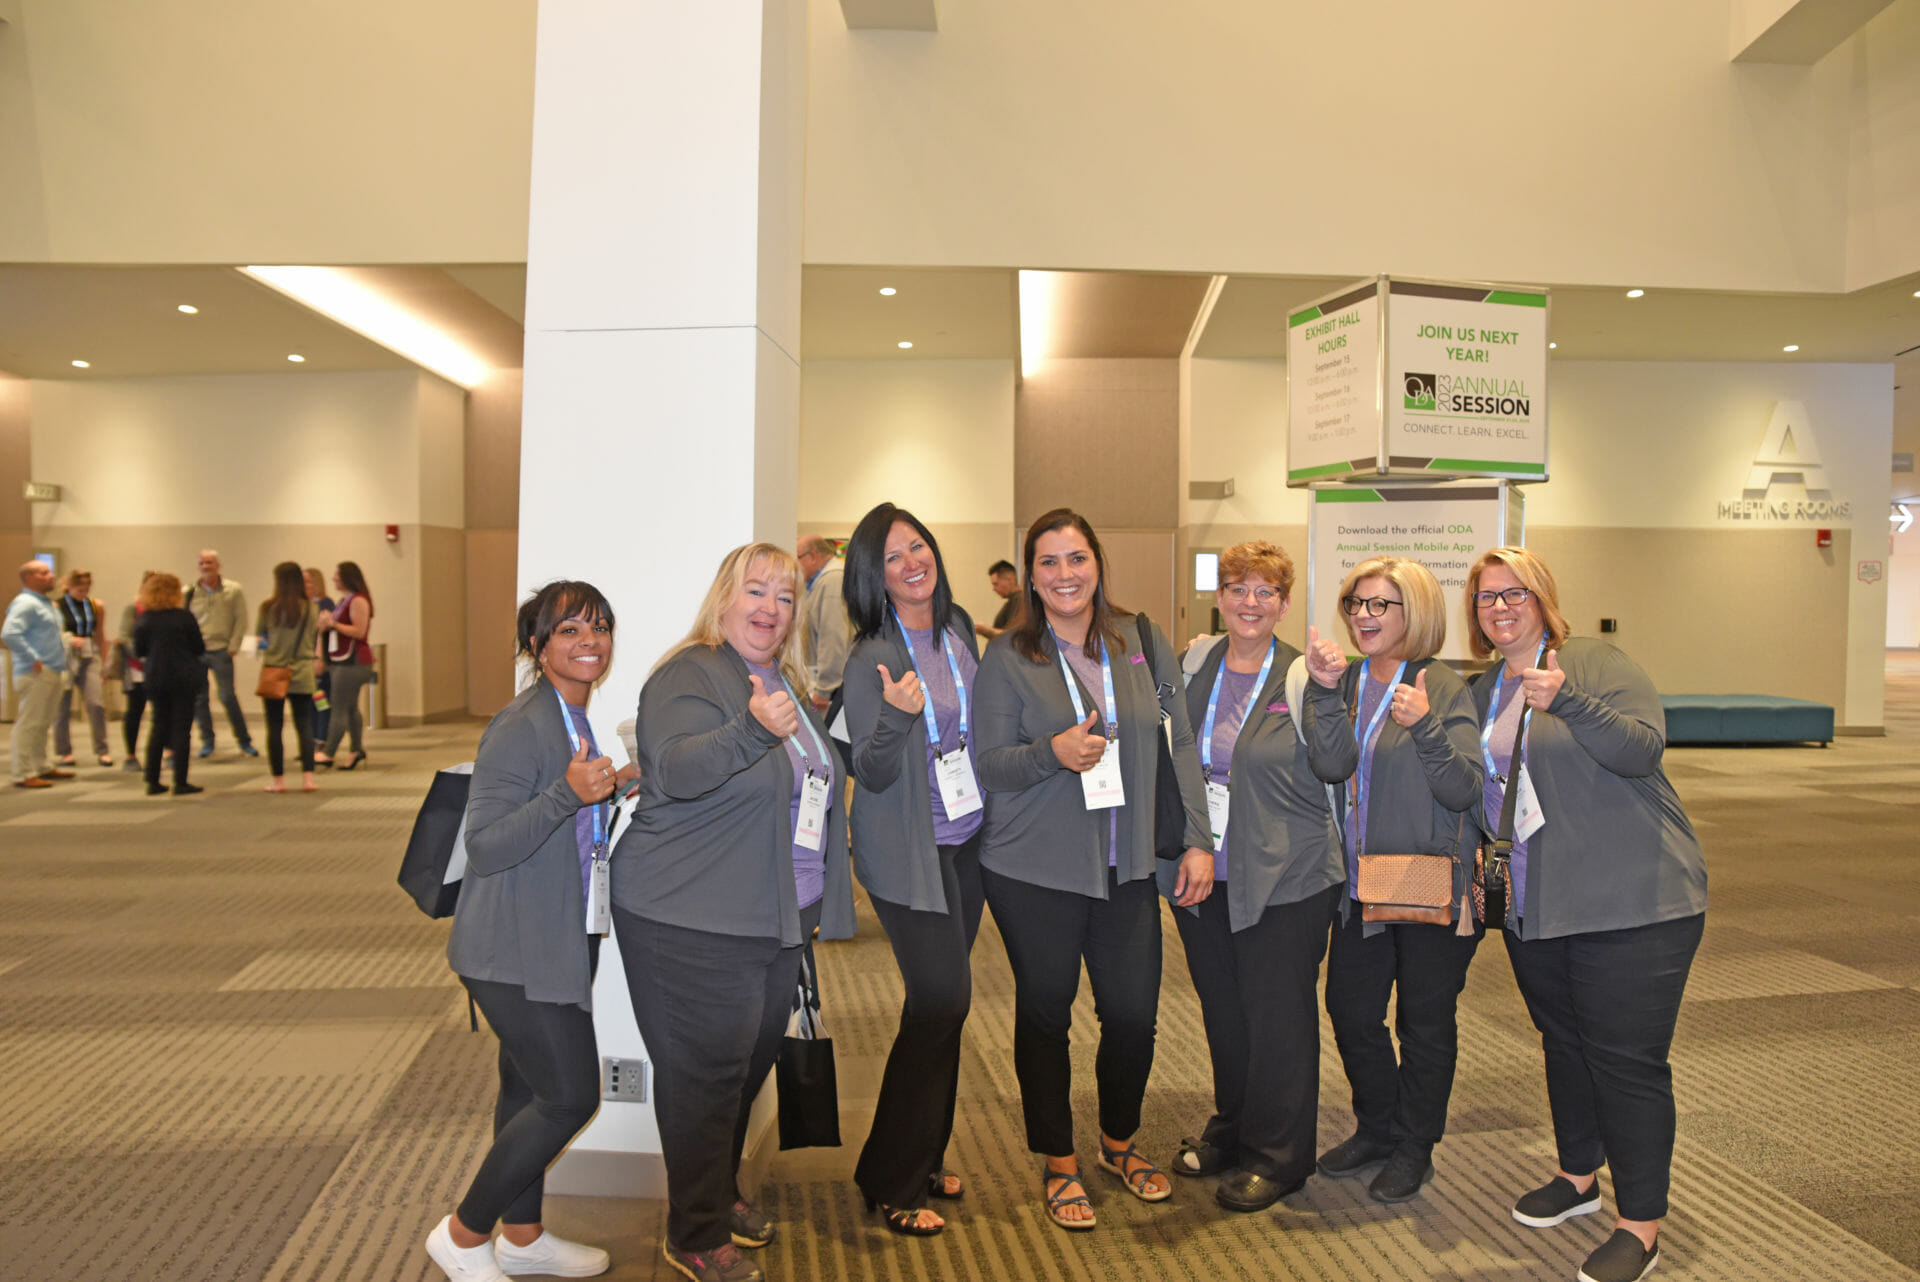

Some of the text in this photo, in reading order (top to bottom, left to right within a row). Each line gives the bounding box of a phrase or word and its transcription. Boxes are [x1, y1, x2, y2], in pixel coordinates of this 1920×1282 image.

[1305, 310, 1361, 340] EXHIBIT HALL
[1417, 325, 1519, 345] JOIN US NEXT
[1318, 335, 1347, 355] HOURS
[1446, 347, 1489, 363] YEAR!
[1438, 374, 1452, 412] 2023
[1452, 376, 1529, 398] ANNUAL
[1452, 394, 1530, 416] SESSION
[1457, 426, 1492, 438] LEARN.
[1496, 428, 1529, 440] EXCEL.
[1743, 400, 1824, 490] A
[1718, 500, 1851, 518] MEETING ROOMS
[1337, 524, 1474, 535] Download the official ODA
[1336, 542, 1475, 553] Annual Session Mobile App
[1341, 560, 1356, 569] for
